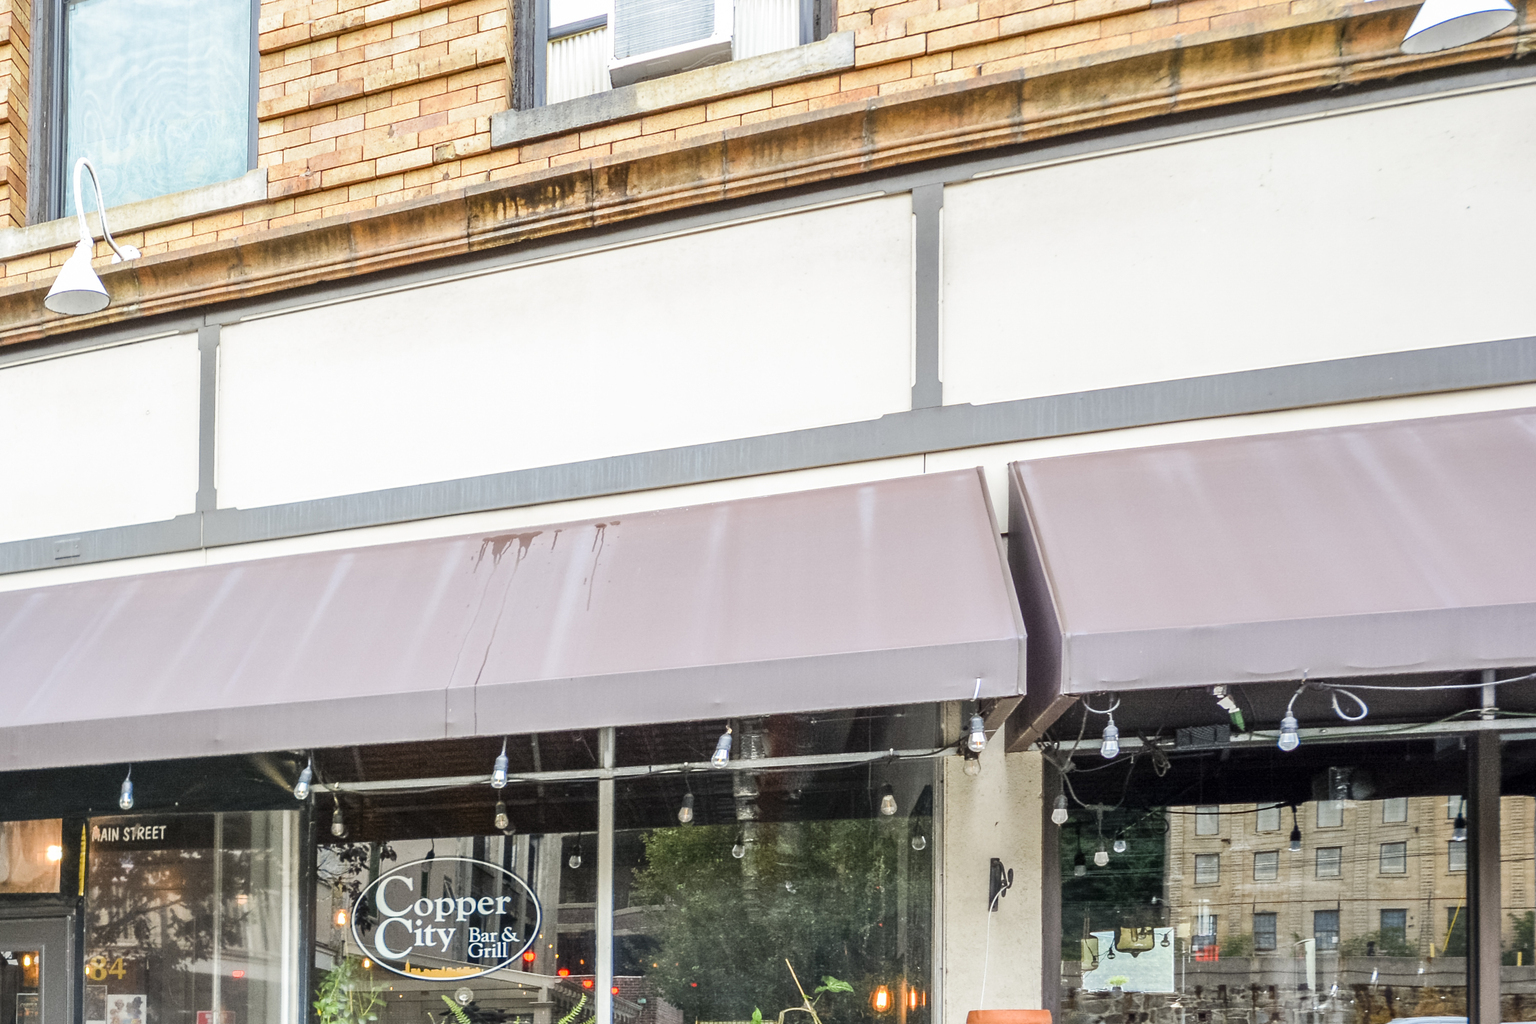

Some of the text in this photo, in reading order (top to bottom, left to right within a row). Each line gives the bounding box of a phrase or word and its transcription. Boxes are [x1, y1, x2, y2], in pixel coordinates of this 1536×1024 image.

[91, 825, 167, 842] MAIN STREET
[375, 875, 511, 922] Copper
[374, 917, 456, 959] City
[468, 926, 520, 943] Bar &
[468, 942, 508, 958] Grill
[89, 955, 127, 981] 84
